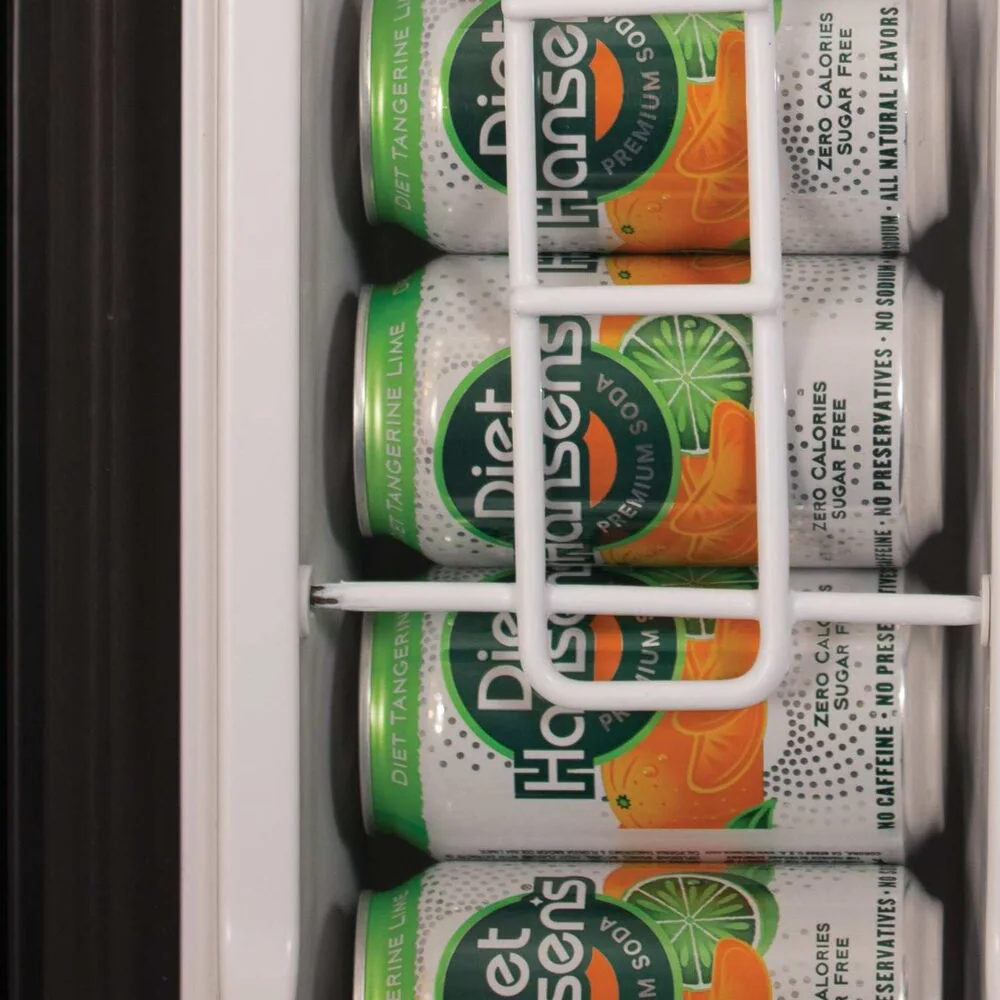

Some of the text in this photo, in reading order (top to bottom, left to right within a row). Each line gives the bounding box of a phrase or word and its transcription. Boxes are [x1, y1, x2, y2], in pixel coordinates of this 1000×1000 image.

[879, 7, 899, 82] FLAVORS
[391, 26, 410, 160] TANGERINE
[601, 16, 661, 176] PREMIUM SOD
[817, 12, 833, 171] ZERO CALORIES
[837, 28, 852, 155] SUGAR FREE
[879, 89, 898, 169] NATURAL
[394, 166, 411, 210] DIET
[880, 175, 899, 201] ALL
[875, 265, 897, 306] SODIUM
[386, 321, 406, 376] LIME
[875, 311, 893, 331] NO
[386, 387, 403, 512] TANGERINE
[596, 373, 655, 533] PREMIUM SODA
[873, 348, 892, 491] PRESERVATIVES
[811, 381, 827, 531] ZERO CALORIES
[832, 399, 847, 519] SUGAR FREE
[873, 496, 892, 516] NO
[814, 672, 830, 727] ZERO
[834, 644, 849, 710] SUGAR
[875, 682, 894, 706] NO
[391, 733, 409, 786] DIET
[875, 725, 895, 807] CAFFEINE
[877, 811, 896, 830] NO
[600, 916, 650, 970] SODA
[815, 922, 831, 1000] ALORIES
[834, 938, 849, 985] FREE
